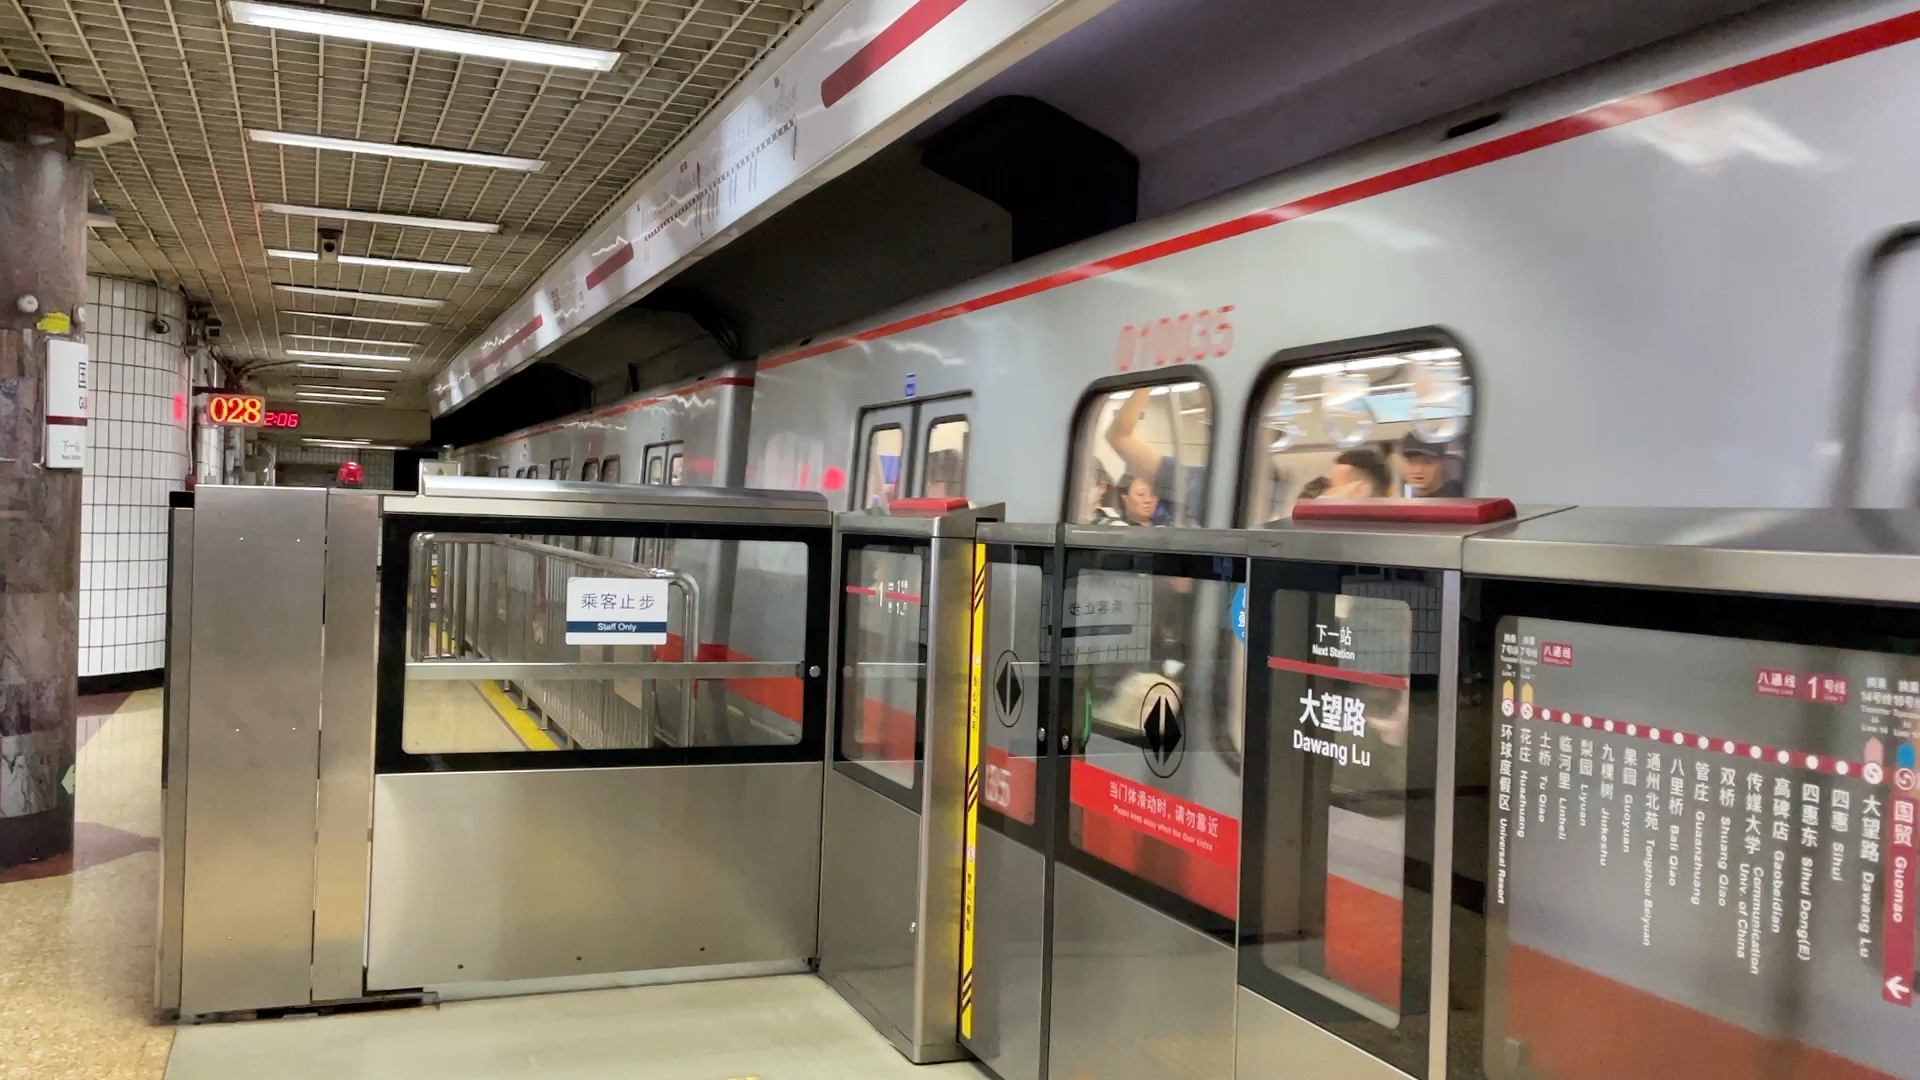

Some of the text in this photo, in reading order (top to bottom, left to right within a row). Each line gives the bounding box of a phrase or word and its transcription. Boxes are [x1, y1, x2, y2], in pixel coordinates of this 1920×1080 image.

[210, 397, 261, 424] 028
[581, 592, 655, 610] 乘客止步
[597, 622, 637, 633] Staff Only
[1316, 624, 1352, 646] 下一站
[1312, 644, 1355, 660] Next Station
[1293, 729, 1371, 767] Dawang Lu
[1300, 688, 1366, 737] 大望路
[1499, 724, 1514, 811] 环球度假区
[1517, 728, 1532, 838] 花庄 Huazhuang
[1538, 794, 1547, 823] Qiao
[1540, 775, 1548, 790] Tu
[1578, 783, 1588, 827] Liyuan
[1600, 743, 1615, 866] 九棵树 Jiukeshu
[1622, 747, 1637, 853] 果园 Guoyuan
[1694, 760, 1711, 802] 管庄
[1498, 818, 1508, 867] Universal
[1558, 797, 1567, 840] Linheli
[1640, 752, 1661, 946] 通州北苑 Tongzhou Beiyuan
[1668, 758, 1684, 887] 八里桥 Bali Qiao
[1717, 767, 1736, 907] 双桥 Shuang Qiao
[1771, 778, 1791, 934] 高碑店 Gaobeidian
[1831, 789, 1849, 881] 四惠 Sihui
[1892, 801, 1914, 923] 国贸 Guomao
[1736, 863, 1750, 958] Univ. of China
[1743, 772, 1764, 975] 传媒大学 Communication
[1797, 784, 1820, 961] 四惠东 Sihui Dong(E)
[1858, 795, 1882, 958] 大望路 Dawang Lu
